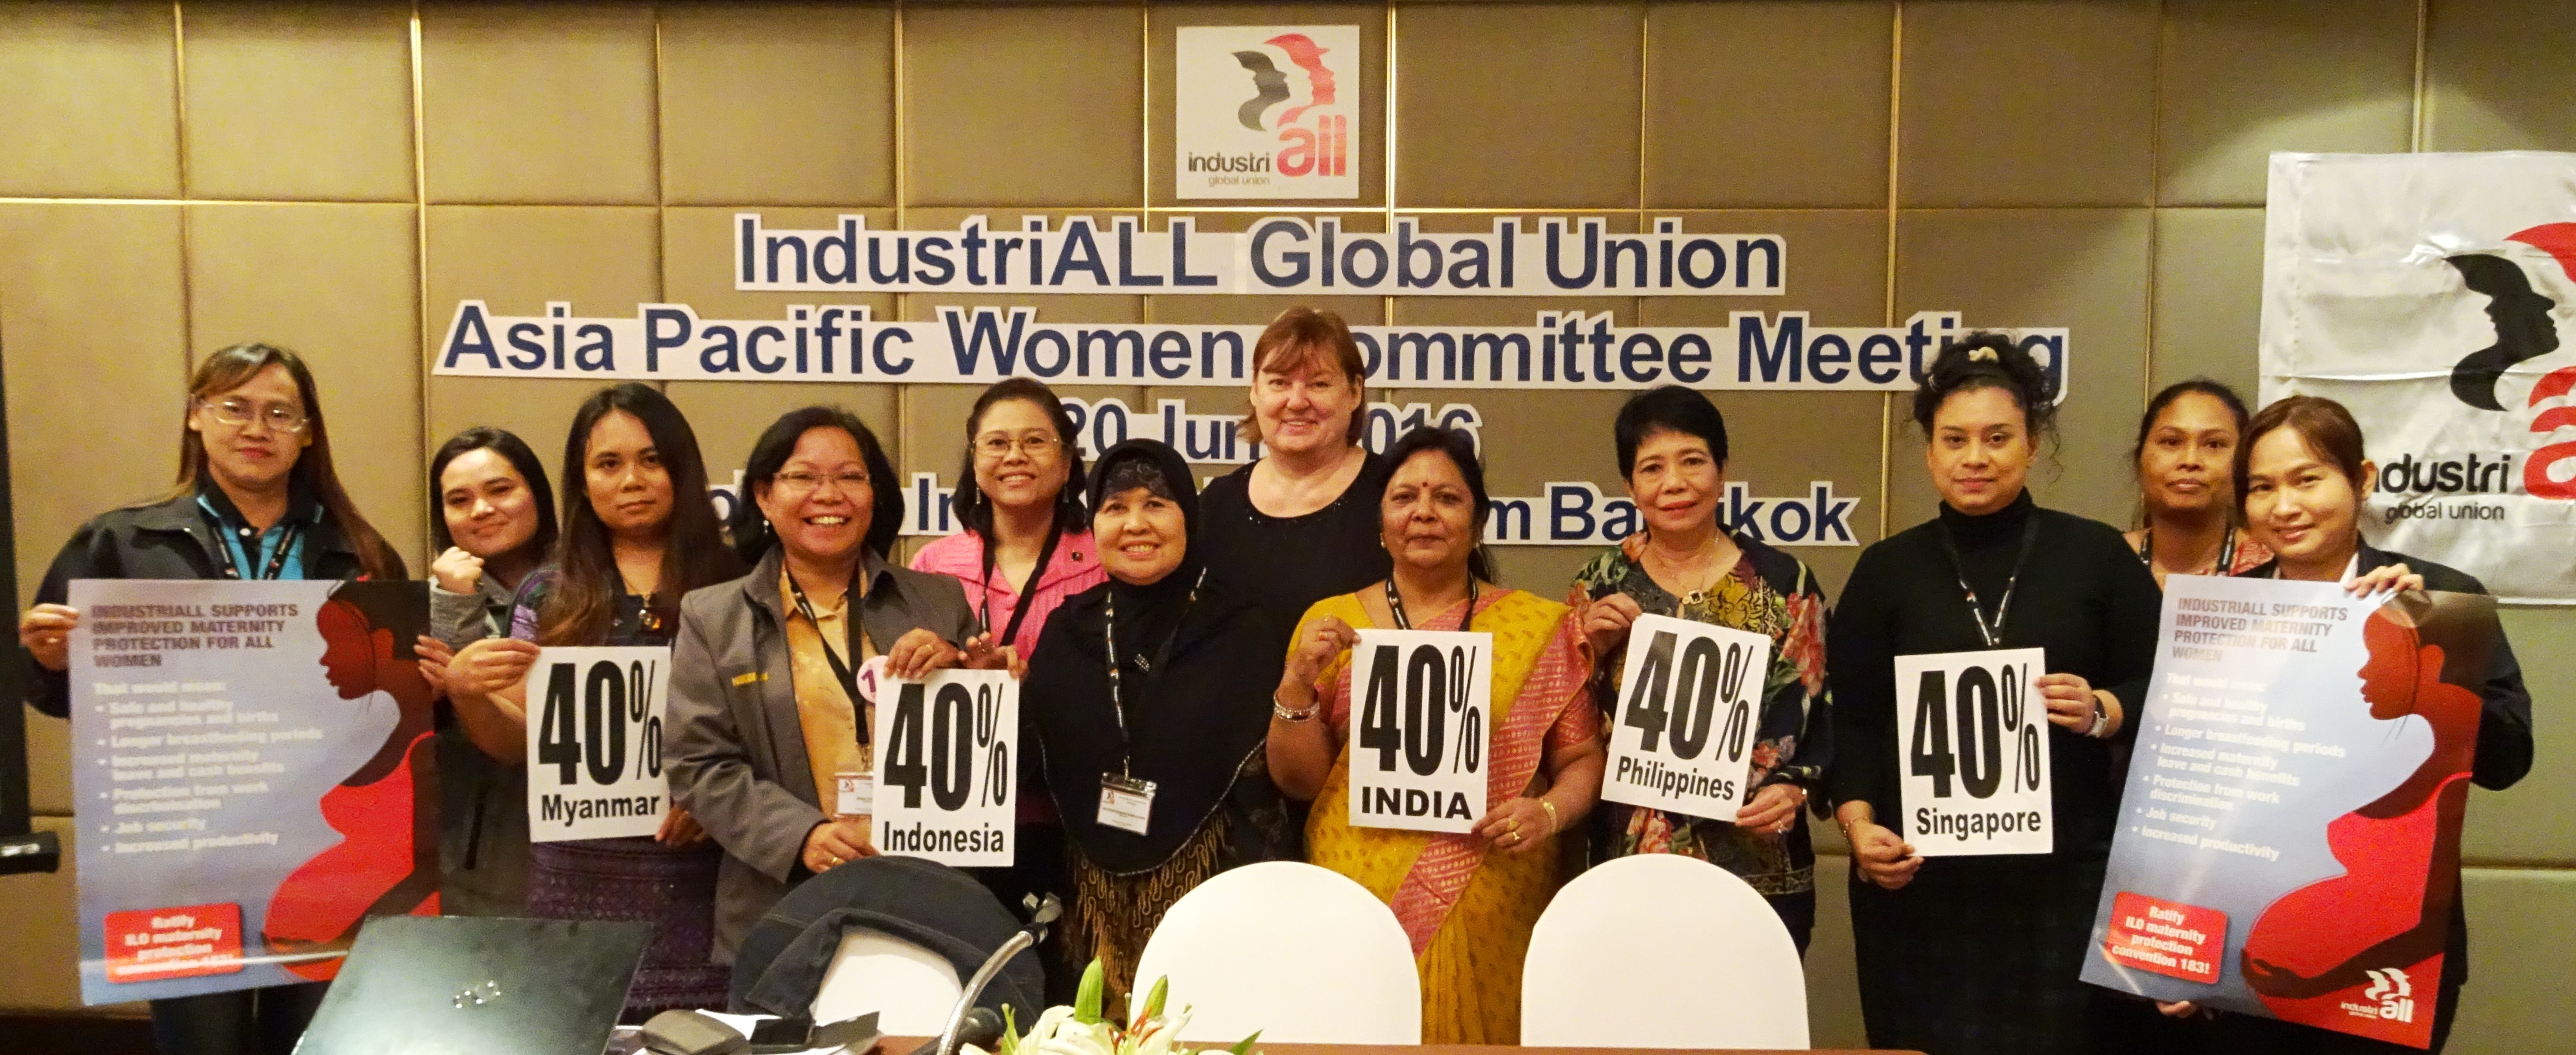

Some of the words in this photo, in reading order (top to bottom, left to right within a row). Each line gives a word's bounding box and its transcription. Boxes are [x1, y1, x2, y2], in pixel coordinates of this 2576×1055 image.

[1189, 152, 1270, 172] industri
[1277, 114, 1346, 177] all
[1209, 175, 1239, 187] global
[1242, 176, 1269, 184] union
[742, 218, 1218, 286] IndustriALL
[1250, 219, 1514, 288] Global
[1545, 221, 1780, 289] Union
[444, 305, 615, 373] Asia
[645, 308, 915, 376] Pacific
[944, 310, 1244, 379] Women
[1349, 316, 1712, 384] ommittee
[1738, 316, 2063, 401] Meetg
[1163, 404, 1260, 460] Jun
[2374, 453, 2511, 493] dustri
[1550, 486, 1850, 541] Bakok
[2385, 502, 2442, 524] global
[2450, 504, 2505, 520] union
[211, 603, 299, 617] SUPPORTS
[2177, 597, 2267, 616] INDUSTRIALL
[2271, 603, 2349, 621] SUPPORTS
[190, 620, 286, 633] MATERNITY
[2175, 613, 2247, 631] IMPROVED
[2251, 618, 2333, 637] MATERNITY
[92, 637, 200, 651] PROTECTION
[207, 636, 239, 650] FOR
[245, 635, 274, 648] ALL
[2172, 645, 2223, 662] WOMEN
[2174, 629, 2258, 648] PROTECTION
[2260, 635, 2288, 651] FOR
[2290, 638, 2318, 653] ALL
[1360, 644, 1481, 776] 40%
[1624, 630, 1754, 763] 40%
[2172, 692, 2197, 706] Safe
[538, 659, 662, 785] 40%
[1910, 662, 2041, 799] 40%
[2240, 713, 2265, 726] and
[884, 682, 1008, 812] 40%
[2166, 724, 2204, 740] Longer
[2205, 727, 2290, 754] breastfeeding
[2292, 740, 2346, 758] periods
[2156, 755, 2187, 770] leave
[2189, 761, 2212, 774] and
[2213, 764, 2244, 778] cash
[2245, 767, 2301, 787] benefits
[2160, 743, 2216, 760] Increased
[2217, 751, 2279, 772] maternity
[1616, 755, 1735, 801] Philippines
[2153, 774, 2211, 793] Protection
[2213, 782, 2245, 799] from
[2246, 789, 2280, 805] work
[541, 793, 661, 827] Myanmar
[1362, 786, 1473, 820] INDIA
[2149, 787, 2234, 811] discrimination
[1916, 807, 2041, 841] Singapore
[2145, 806, 2167, 820] Job
[2168, 812, 2217, 831] security
[884, 821, 1004, 852] Indonesia
[2141, 824, 2199, 846] Increased
[2199, 837, 2280, 862] productivity
[2125, 915, 2145, 930] ILO
[2146, 922, 2207, 945] maternity
[2149, 905, 2185, 926] Ratify
[2111, 944, 2177, 968] convention
[2180, 958, 2211, 975] 183!
[2131, 934, 2194, 956] protection
[2379, 997, 2414, 1023] all
